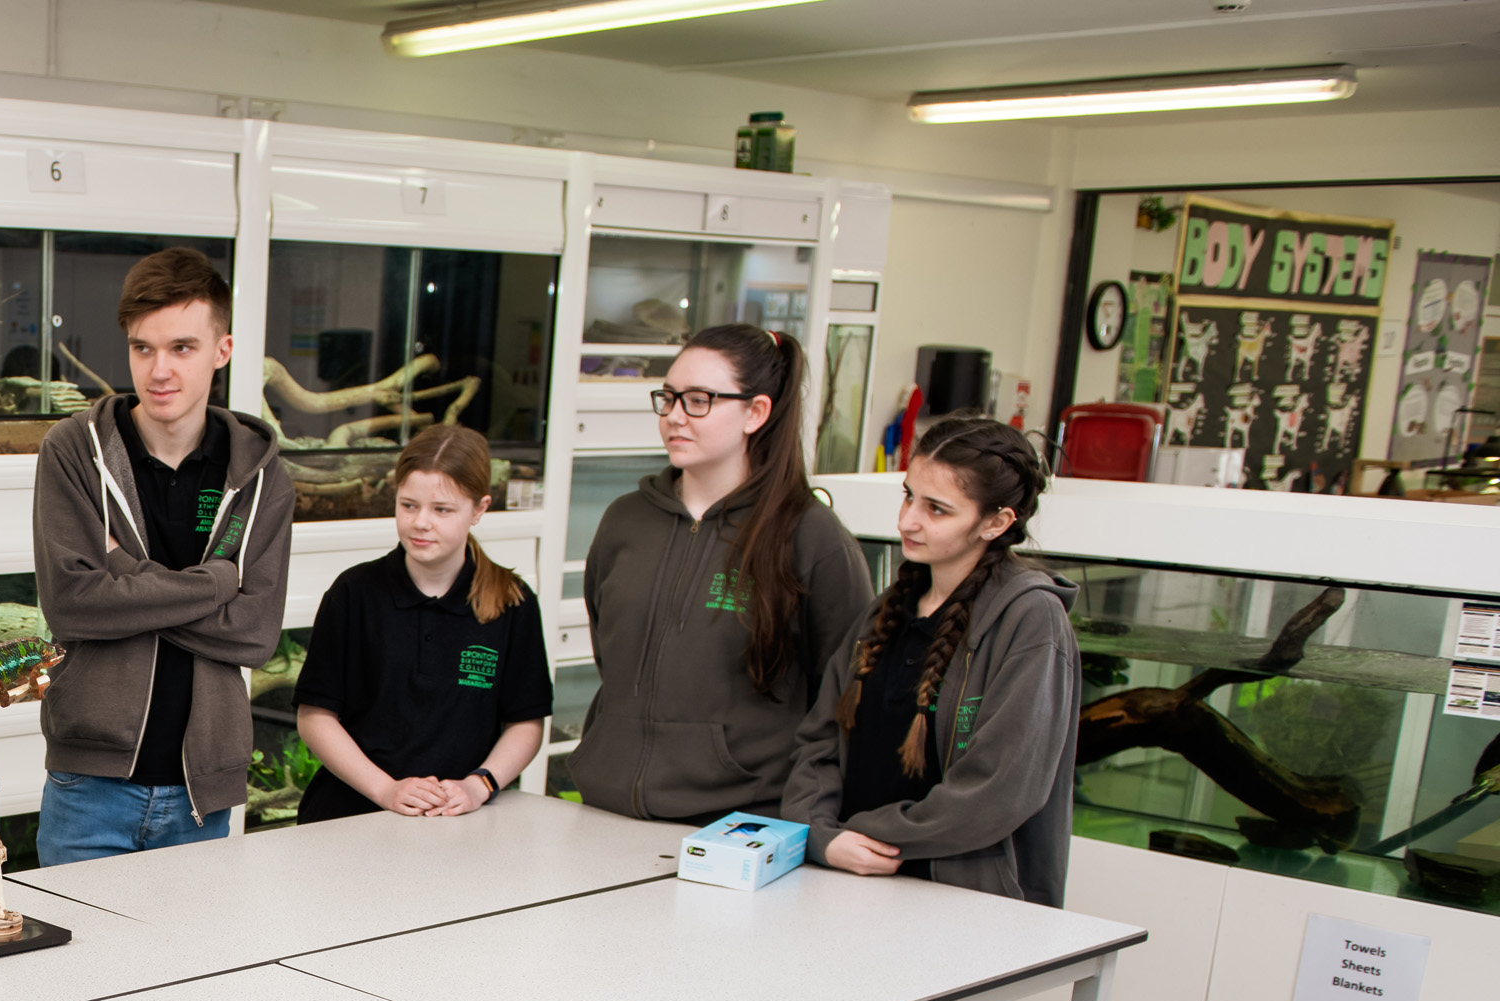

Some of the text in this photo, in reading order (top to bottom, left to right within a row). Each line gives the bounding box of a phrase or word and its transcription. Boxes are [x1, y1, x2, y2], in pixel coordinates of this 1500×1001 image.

[51, 160, 62, 182] 6
[419, 186, 428, 205] 7
[720, 204, 730, 222] 8
[1179, 217, 1388, 299] BODY SYSTEMS
[1344, 939, 1387, 958] Towels
[1341, 958, 1382, 977] Sheets
[1332, 976, 1384, 997] Blankets
